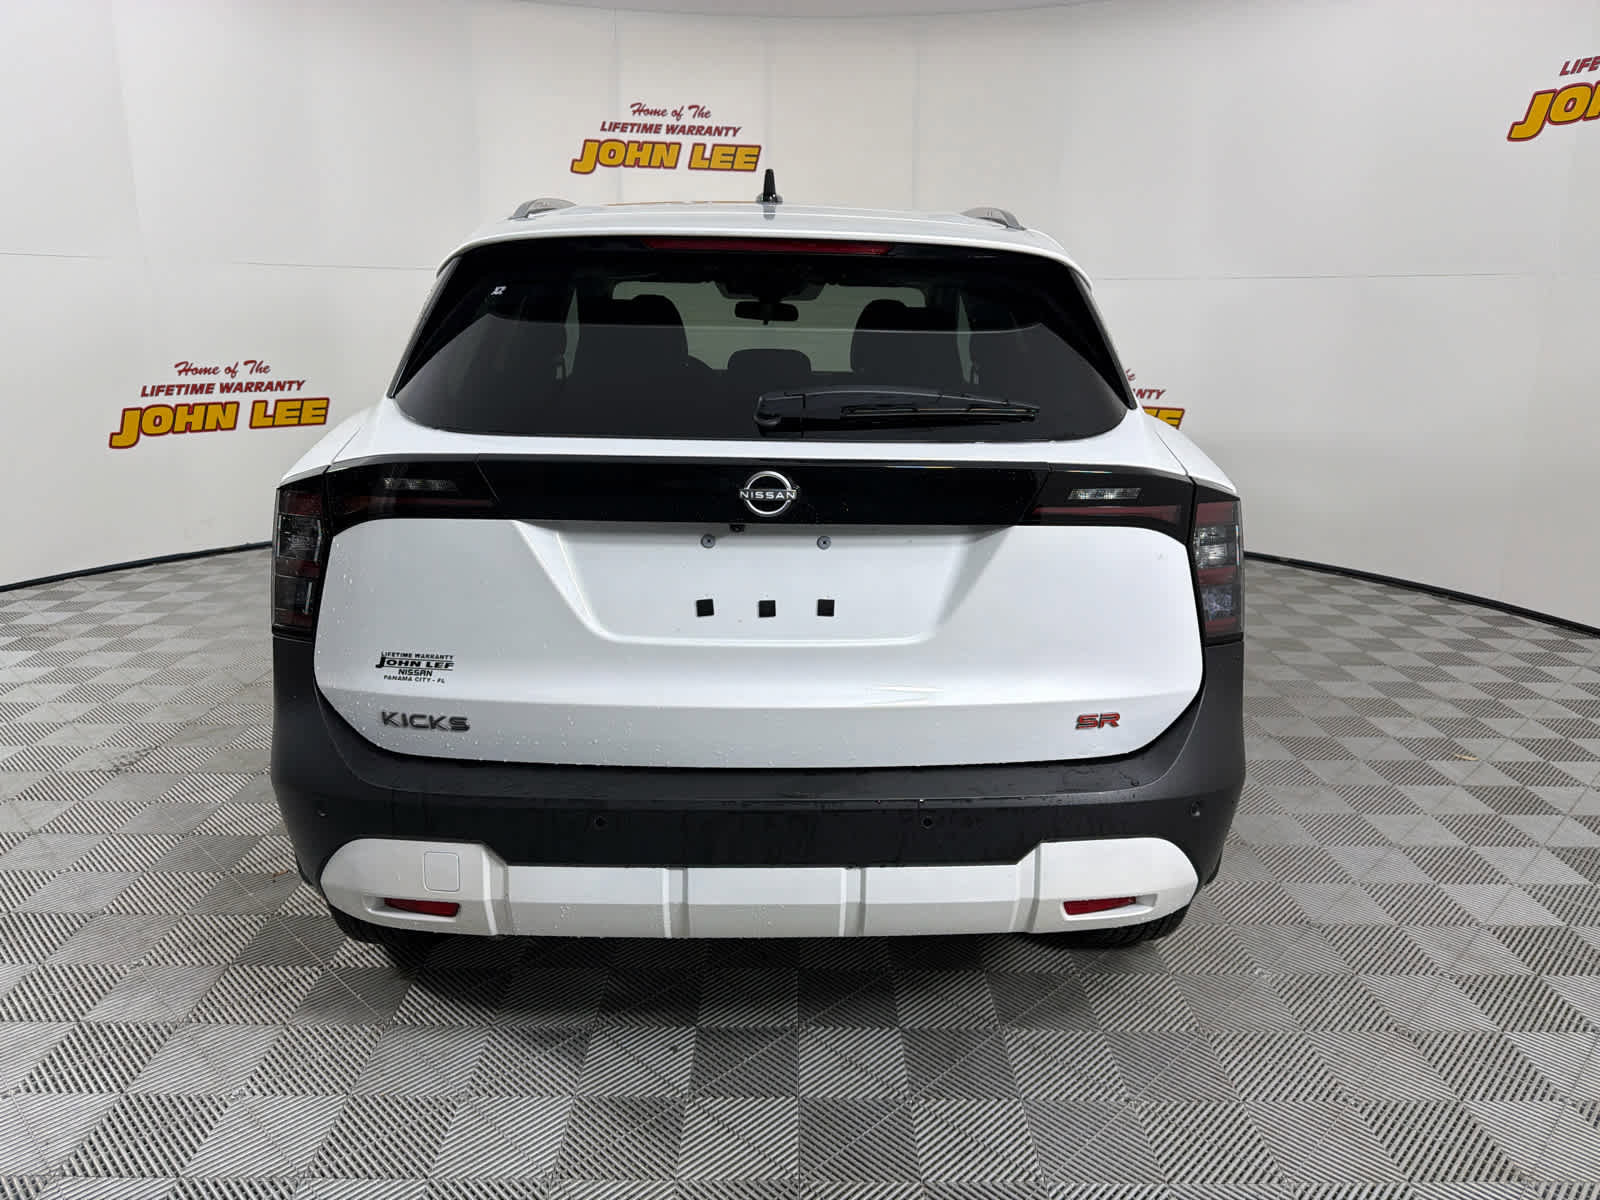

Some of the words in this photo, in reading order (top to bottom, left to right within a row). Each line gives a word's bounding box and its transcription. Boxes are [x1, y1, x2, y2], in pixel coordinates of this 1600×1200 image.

[630, 102, 668, 117] Home
[671, 106, 684, 121] of
[688, 105, 711, 119] The
[600, 121, 662, 134] LIFETIME
[665, 124, 741, 137] WARRANTY
[570, 139, 681, 174] JOHN
[688, 143, 761, 172] LEE
[174, 361, 220, 377] Home
[224, 362, 239, 378] of
[244, 360, 271, 375] The
[140, 383, 215, 397] LIFETIME
[219, 380, 305, 394] WARRANTY
[109, 401, 240, 449] JOHN
[249, 398, 330, 428] LEE
[740, 491, 797, 499] NISSAN
[375, 657, 421, 668] JOHN
[381, 712, 470, 731] KICKS
[1075, 712, 1120, 730] SR
